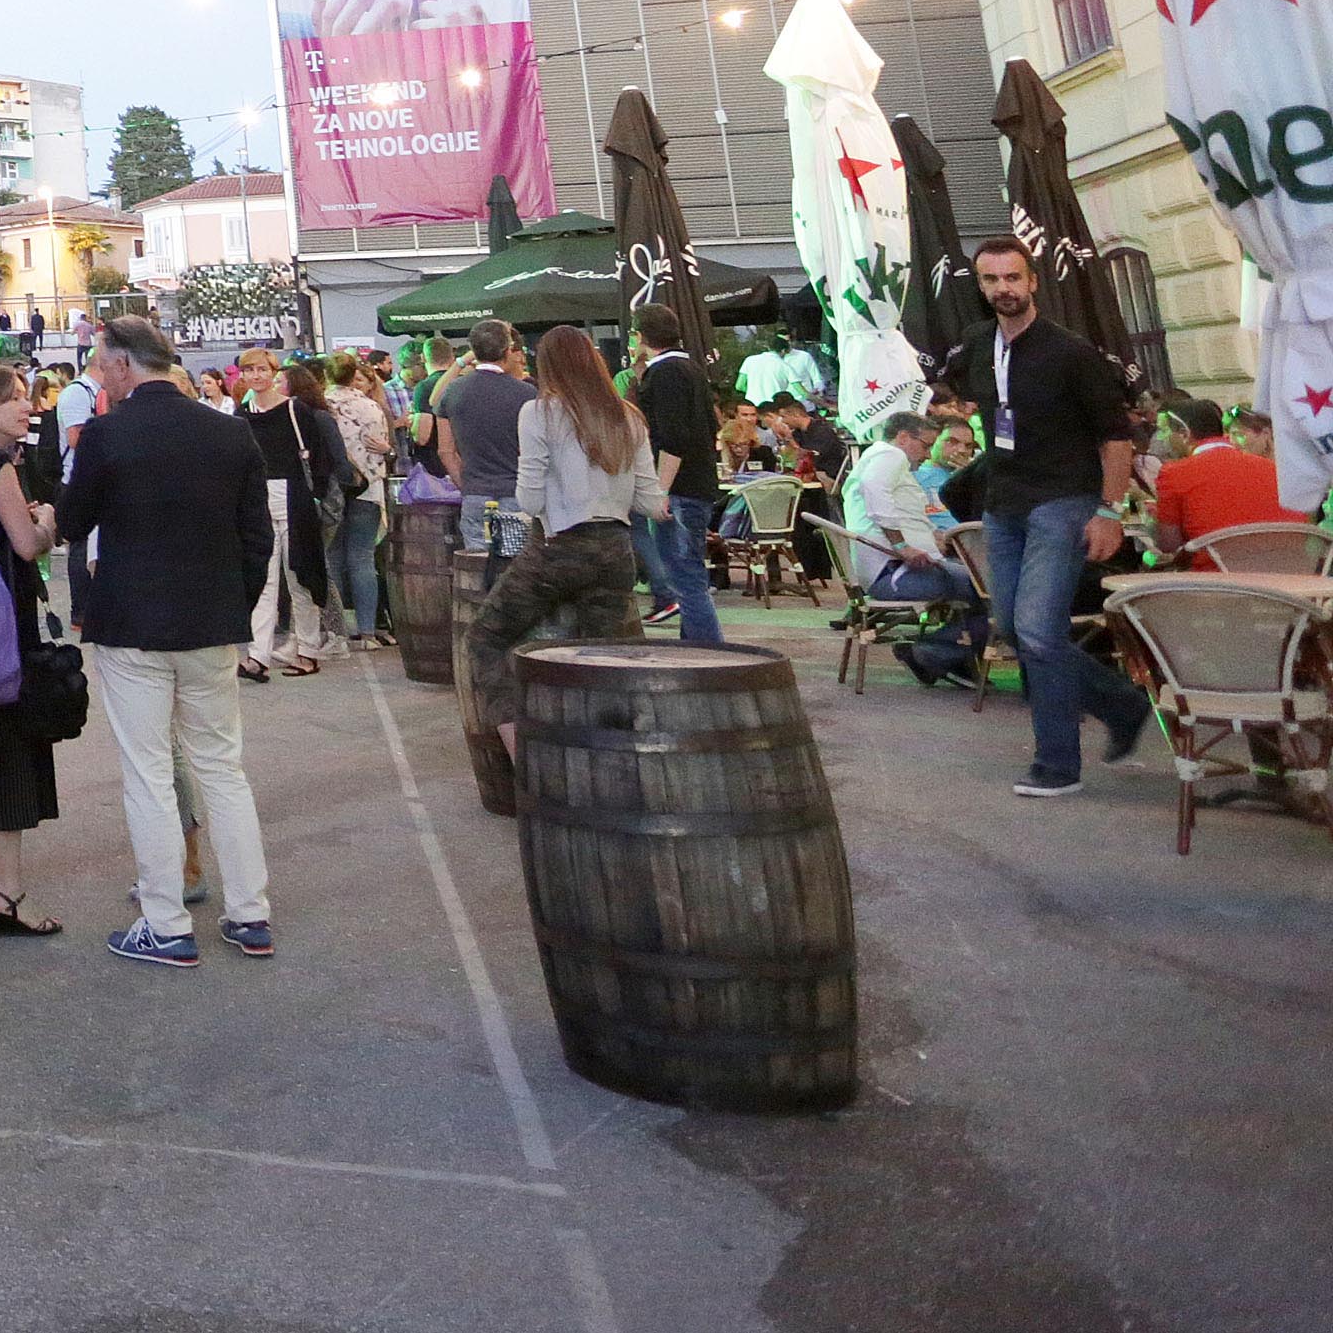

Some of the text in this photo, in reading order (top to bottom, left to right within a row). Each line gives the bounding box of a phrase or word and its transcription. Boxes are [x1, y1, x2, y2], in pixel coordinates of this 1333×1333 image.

[309, 79, 427, 107] WEEKND
[312, 108, 415, 134] ZA NOVE
[315, 130, 481, 161] TEHNOLOGIJE
